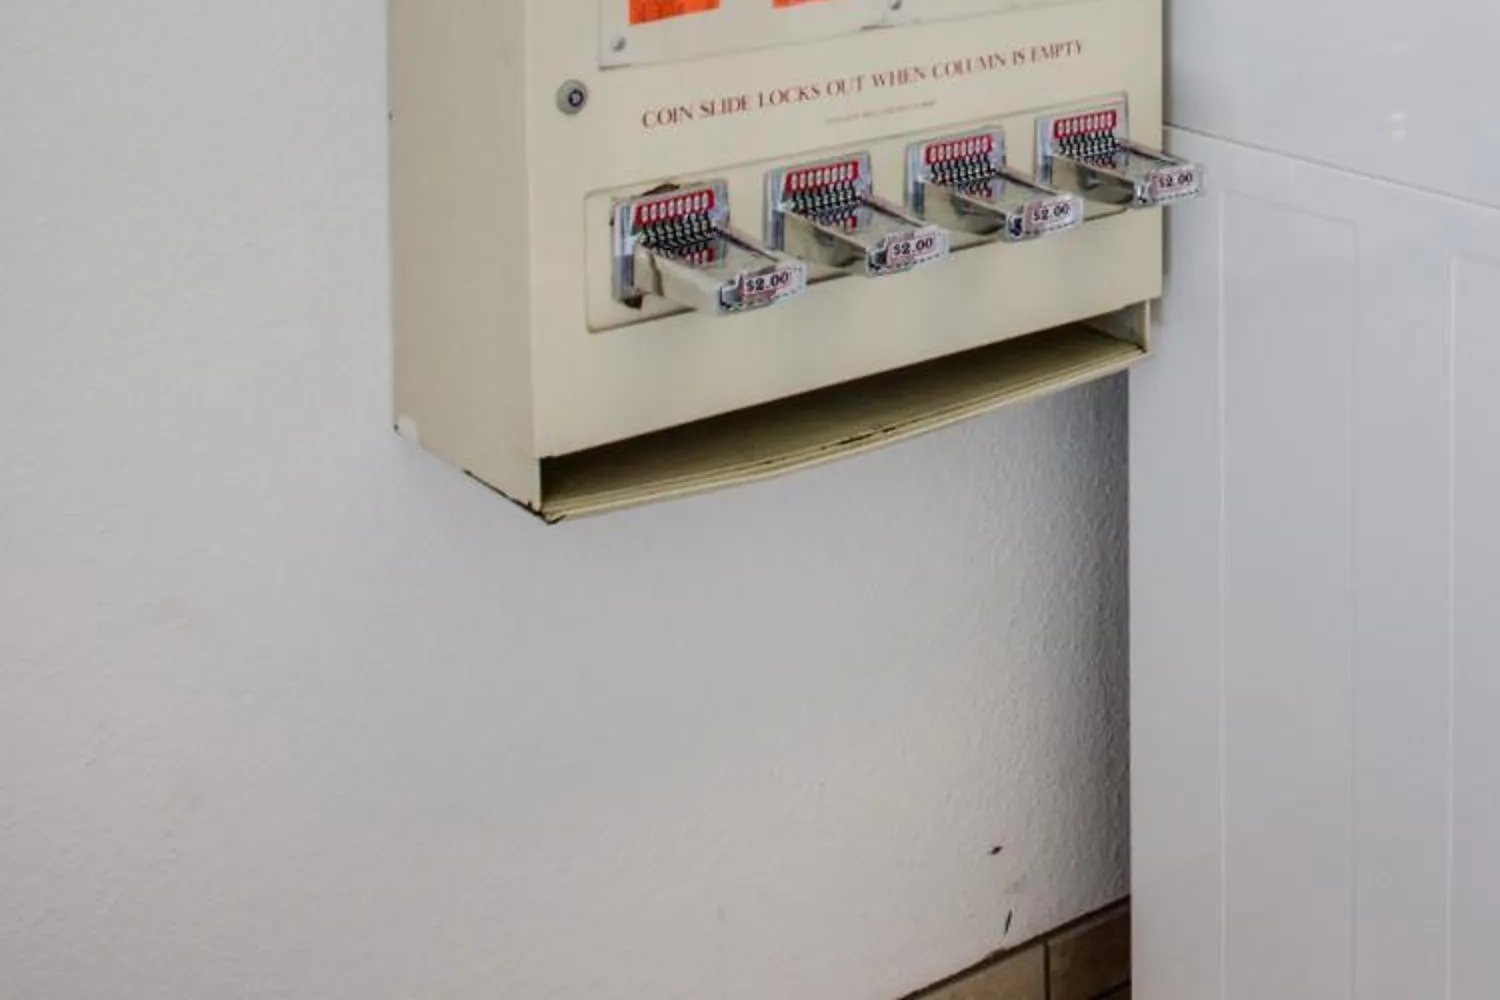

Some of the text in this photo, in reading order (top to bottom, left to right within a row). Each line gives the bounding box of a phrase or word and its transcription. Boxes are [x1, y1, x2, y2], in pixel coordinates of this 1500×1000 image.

[642, 38, 1083, 129] COIN SLIDE LOCKS OUT WHEN COLUMN IS EMPTY
[1158, 173, 1193, 188] $2.00
[1032, 202, 1070, 222] $2.00
[892, 236, 934, 256] $2.00
[745, 271, 789, 293] $2.00
